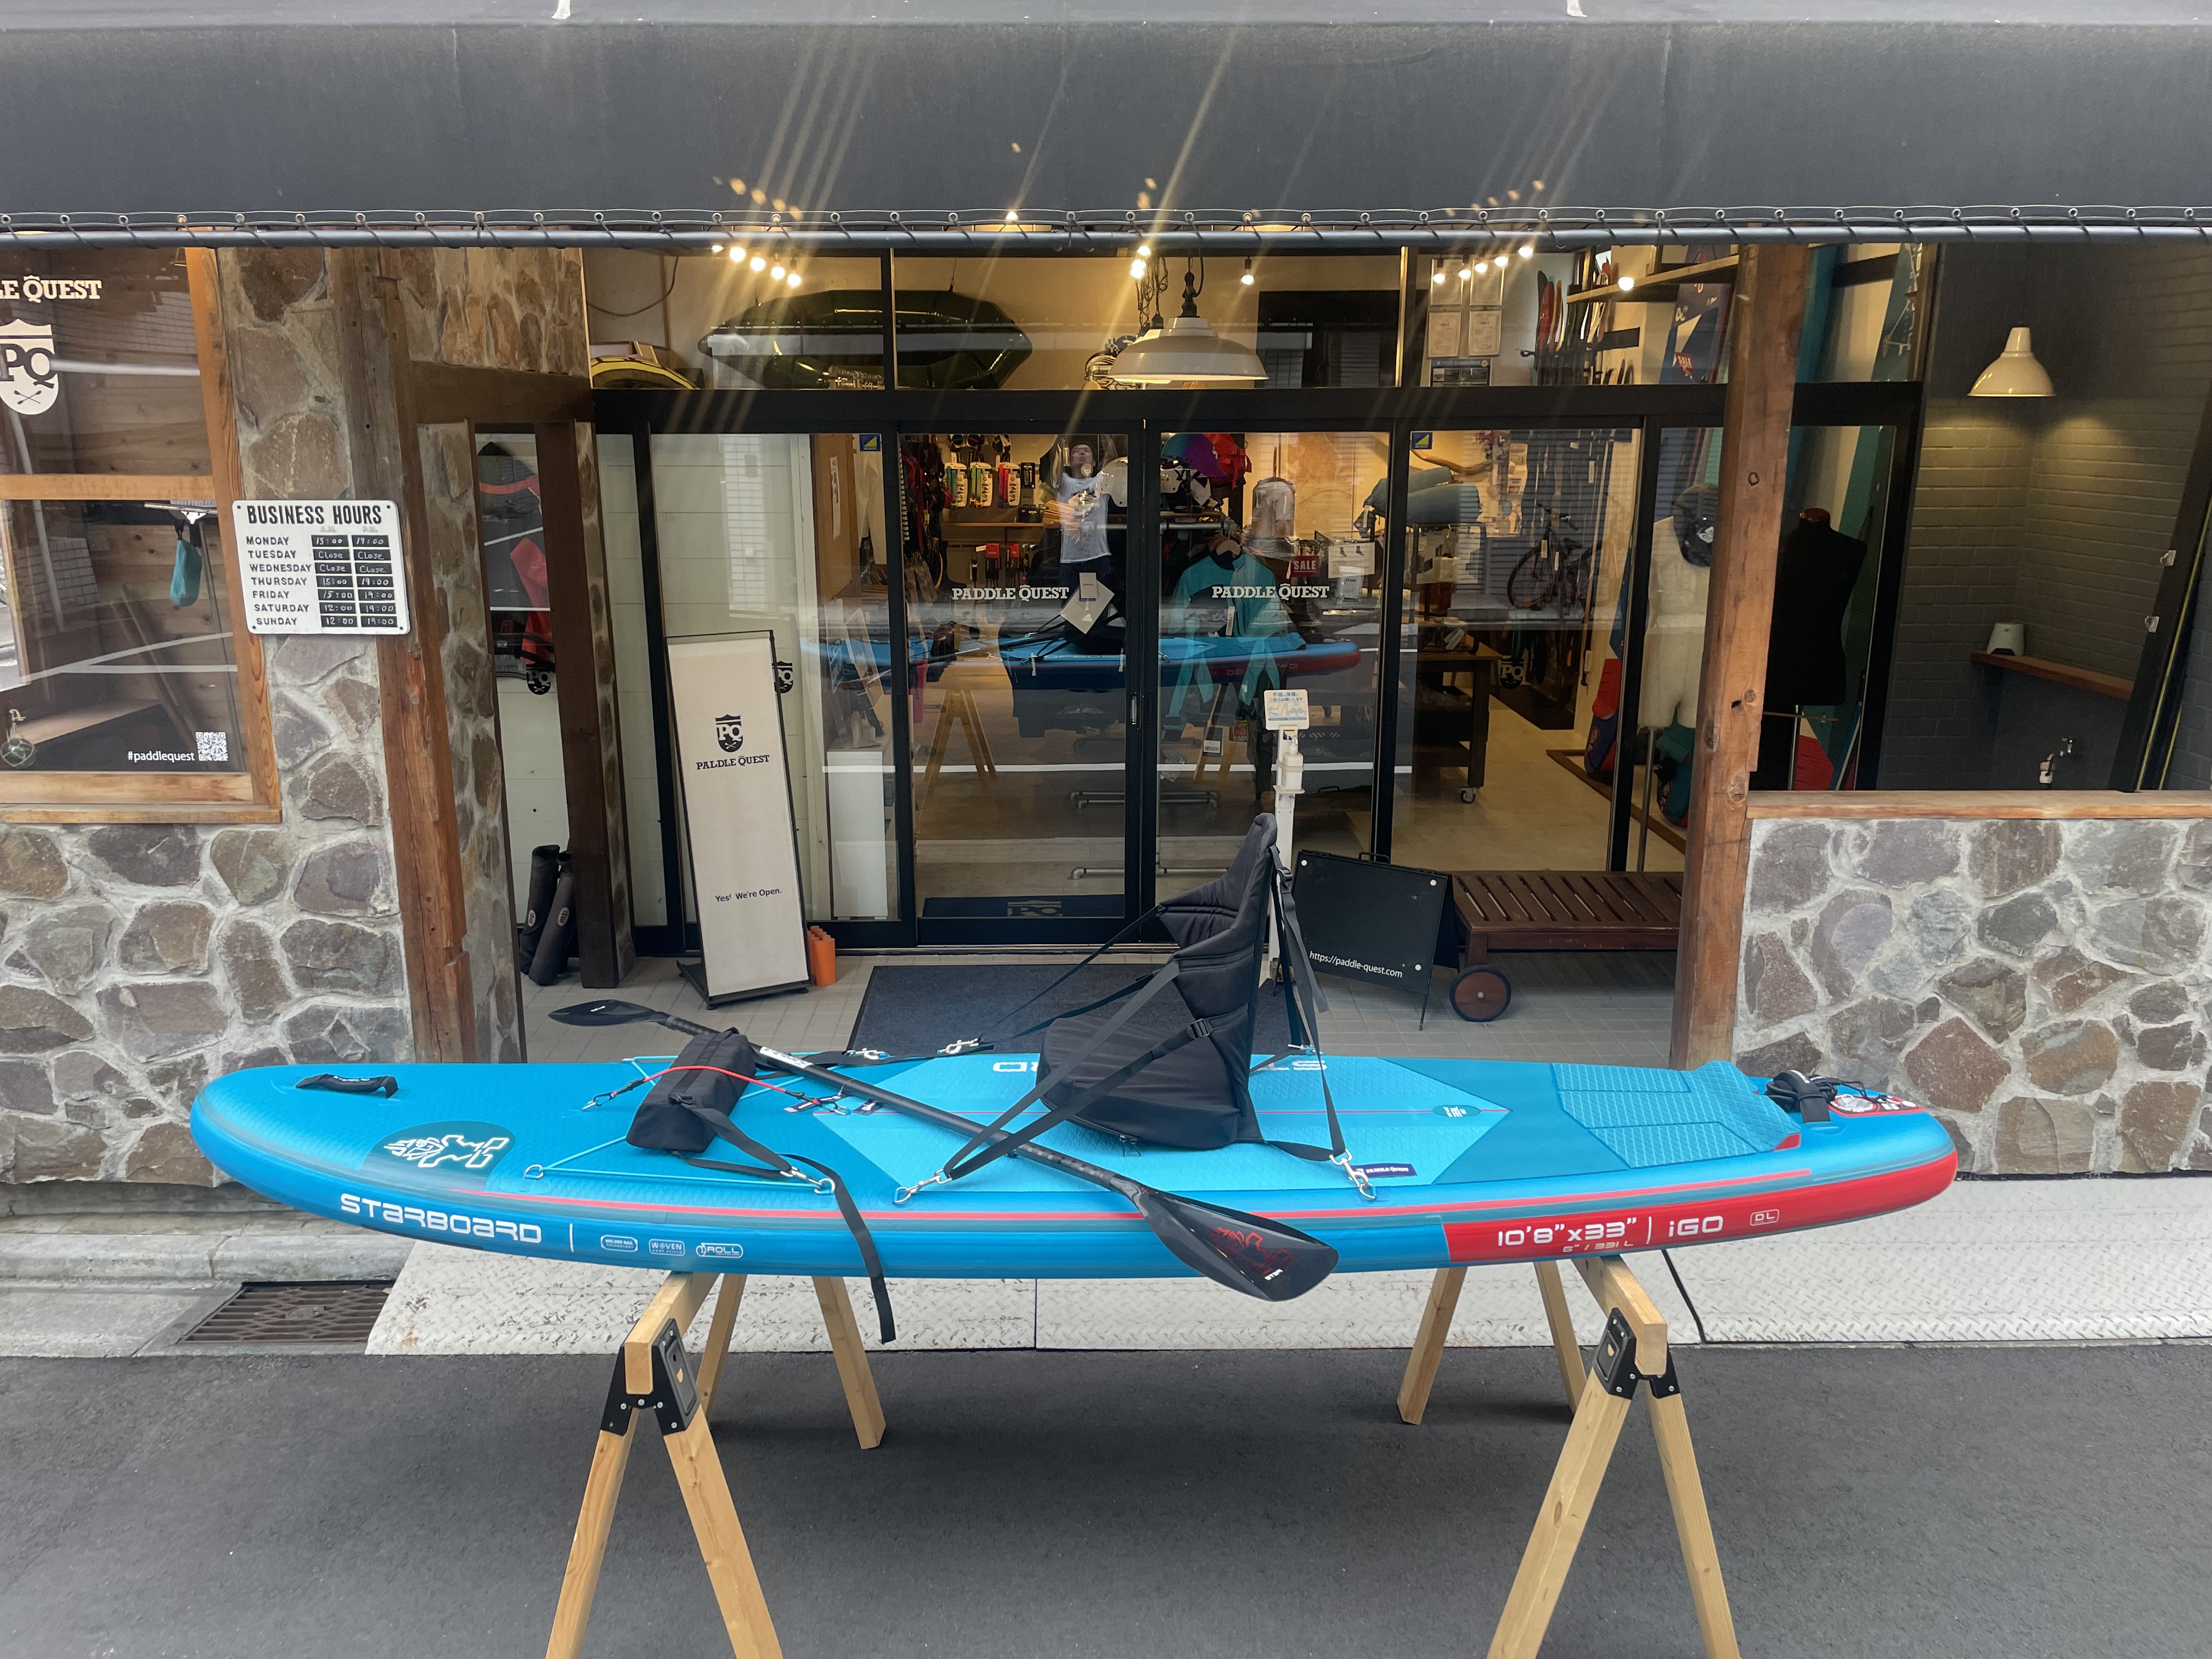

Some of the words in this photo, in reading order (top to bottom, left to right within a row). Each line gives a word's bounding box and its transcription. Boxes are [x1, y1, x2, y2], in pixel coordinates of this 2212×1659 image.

[0, 280, 20, 299] E
[23, 275, 102, 303] QUEST
[247, 505, 324, 524] BUSINESS
[333, 505, 382, 524] HOURS
[246, 537, 289, 545] MONDAY
[248, 550, 297, 558] TUESDAY
[357, 551, 385, 560] Close
[359, 565, 387, 573] Close
[1294, 560, 1316, 570] SALE
[251, 577, 307, 585] THURSDAY
[323, 591, 353, 599] 15:00
[952, 588, 1015, 600] PADDLE
[1018, 584, 1069, 602] QUEST
[1212, 585, 1276, 599] PADDLE
[1278, 583, 1330, 601] QUEST
[254, 604, 310, 612] SATURDAY
[1500, 664, 1524, 681] PQ
[716, 724, 743, 742] PQ
[127, 751, 195, 763] #paddlequest
[738, 754, 770, 766] QUEST
[735, 891, 758, 900] We're
[1309, 951, 1403, 978] https://paddle-quest.com
[1755, 1212, 1775, 1222] DL
[1594, 1242, 1620, 1250] 331
